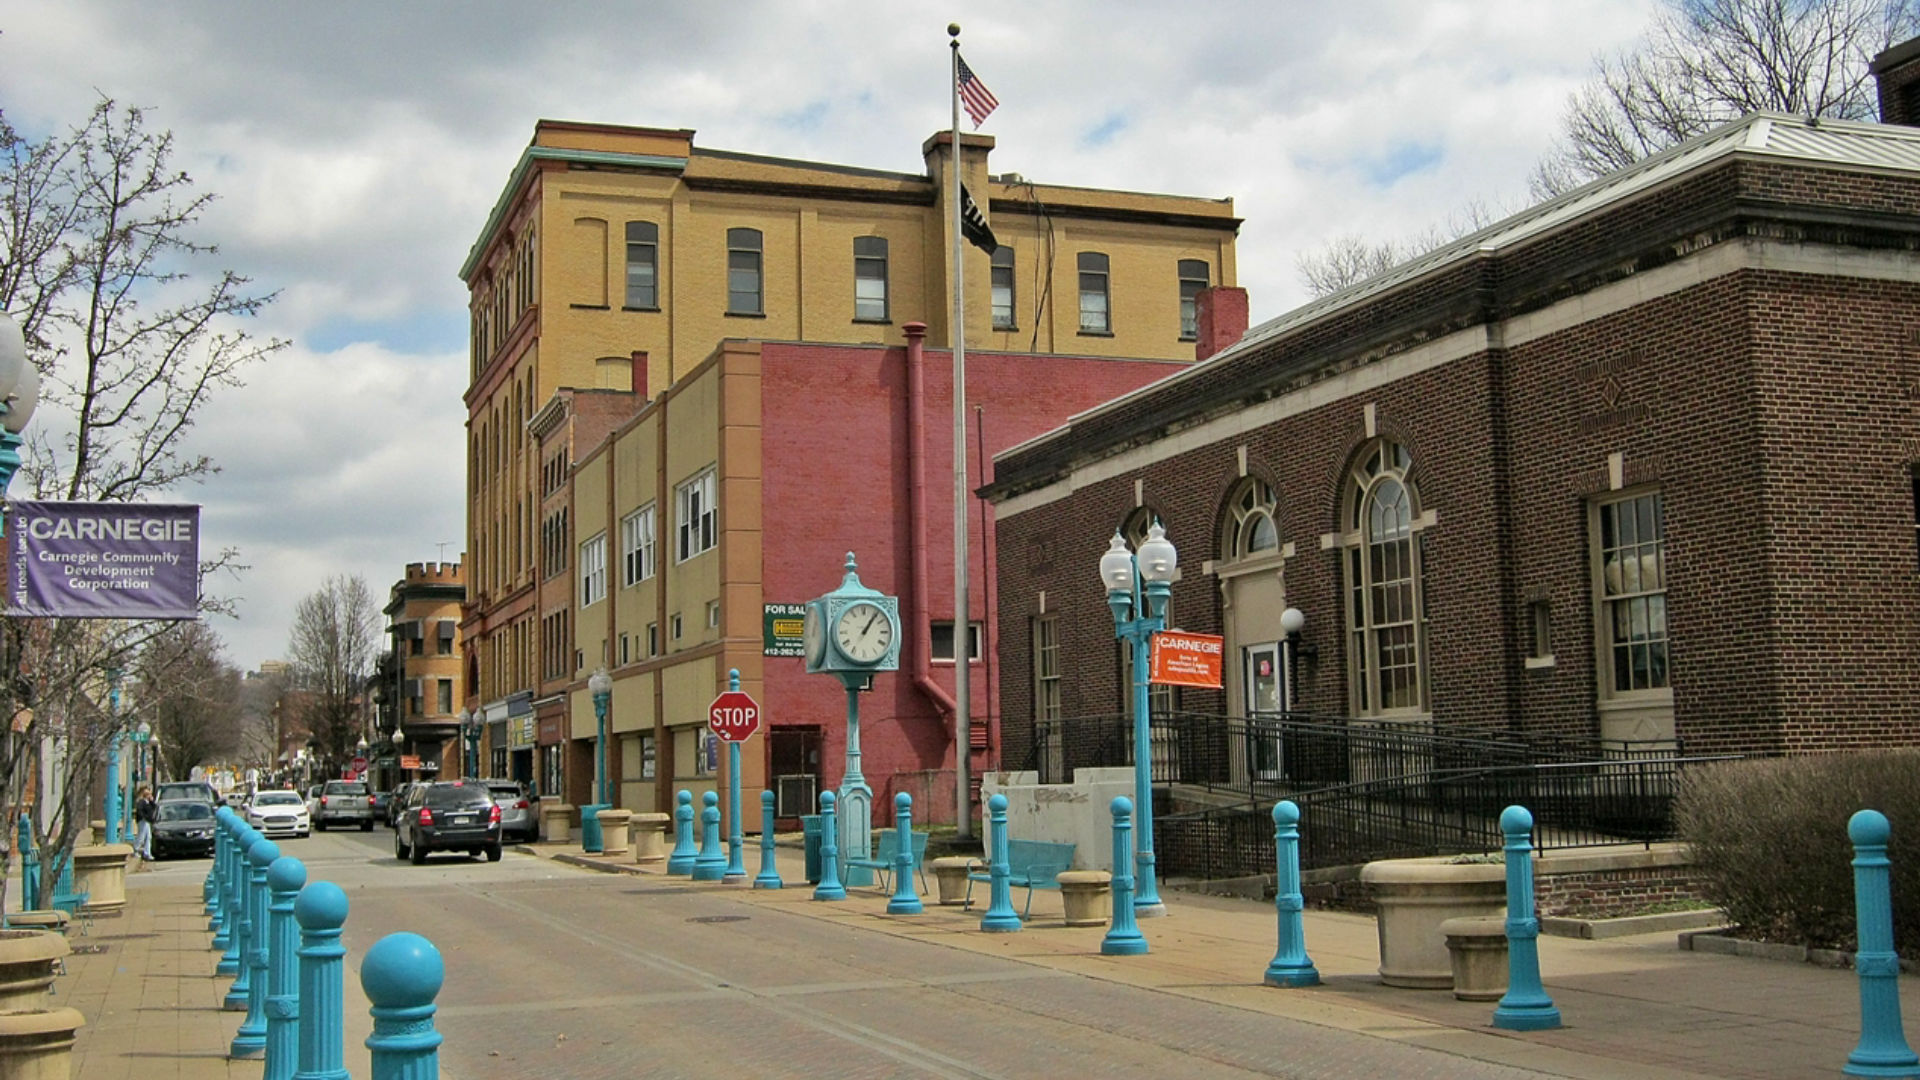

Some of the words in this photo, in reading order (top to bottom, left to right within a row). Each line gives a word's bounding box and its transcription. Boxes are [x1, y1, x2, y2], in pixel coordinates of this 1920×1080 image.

[16, 516, 28, 528] to
[29, 517, 191, 541] CARNEGIE
[16, 531, 28, 555] lead
[39, 550, 98, 565] Carnegie
[102, 551, 180, 566] Community
[16, 556, 28, 588] roads
[64, 564, 155, 578] Development
[69, 578, 149, 592] Corporation
[765, 604, 786, 614] FOR
[787, 605, 806, 615] SAL
[1160, 637, 1221, 654] CARNEGIE
[712, 708, 756, 726] STOP
